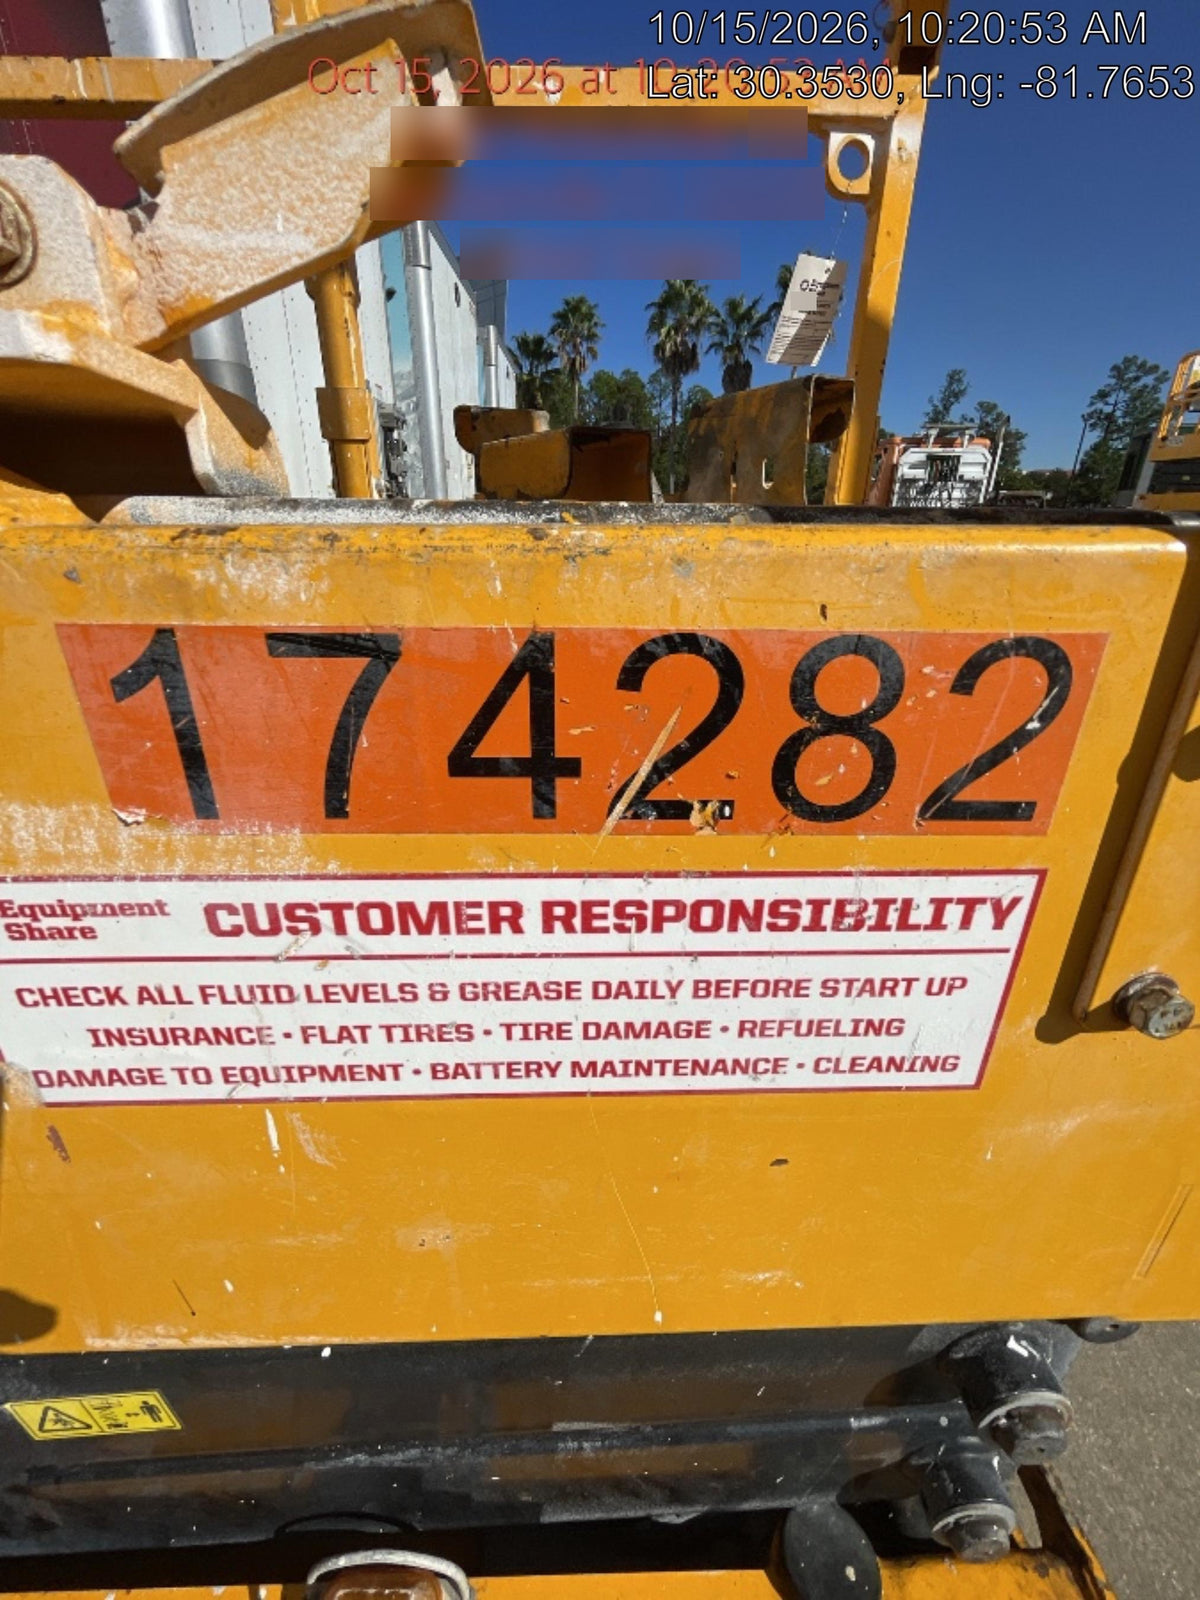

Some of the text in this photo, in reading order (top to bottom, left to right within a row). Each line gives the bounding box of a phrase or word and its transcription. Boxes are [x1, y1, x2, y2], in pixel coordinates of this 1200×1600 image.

[110, 627, 1073, 822] 174282
[0, 898, 171, 922] Equipment
[204, 896, 1023, 938] CUSTOMER RESPONSIBILITY
[6, 922, 99, 941] Share
[15, 976, 969, 1007] CHECK ALL FLUID LEVELS & GREASE DAILY BEFORE START UP
[87, 1018, 905, 1048] INSURANCE FLAT TIRES TIRE DAMAGE REFUELING
[33, 1055, 960, 1087] DAMAGE TO EQUIPMENT BATTERY MAINTENANCE CLEANING
